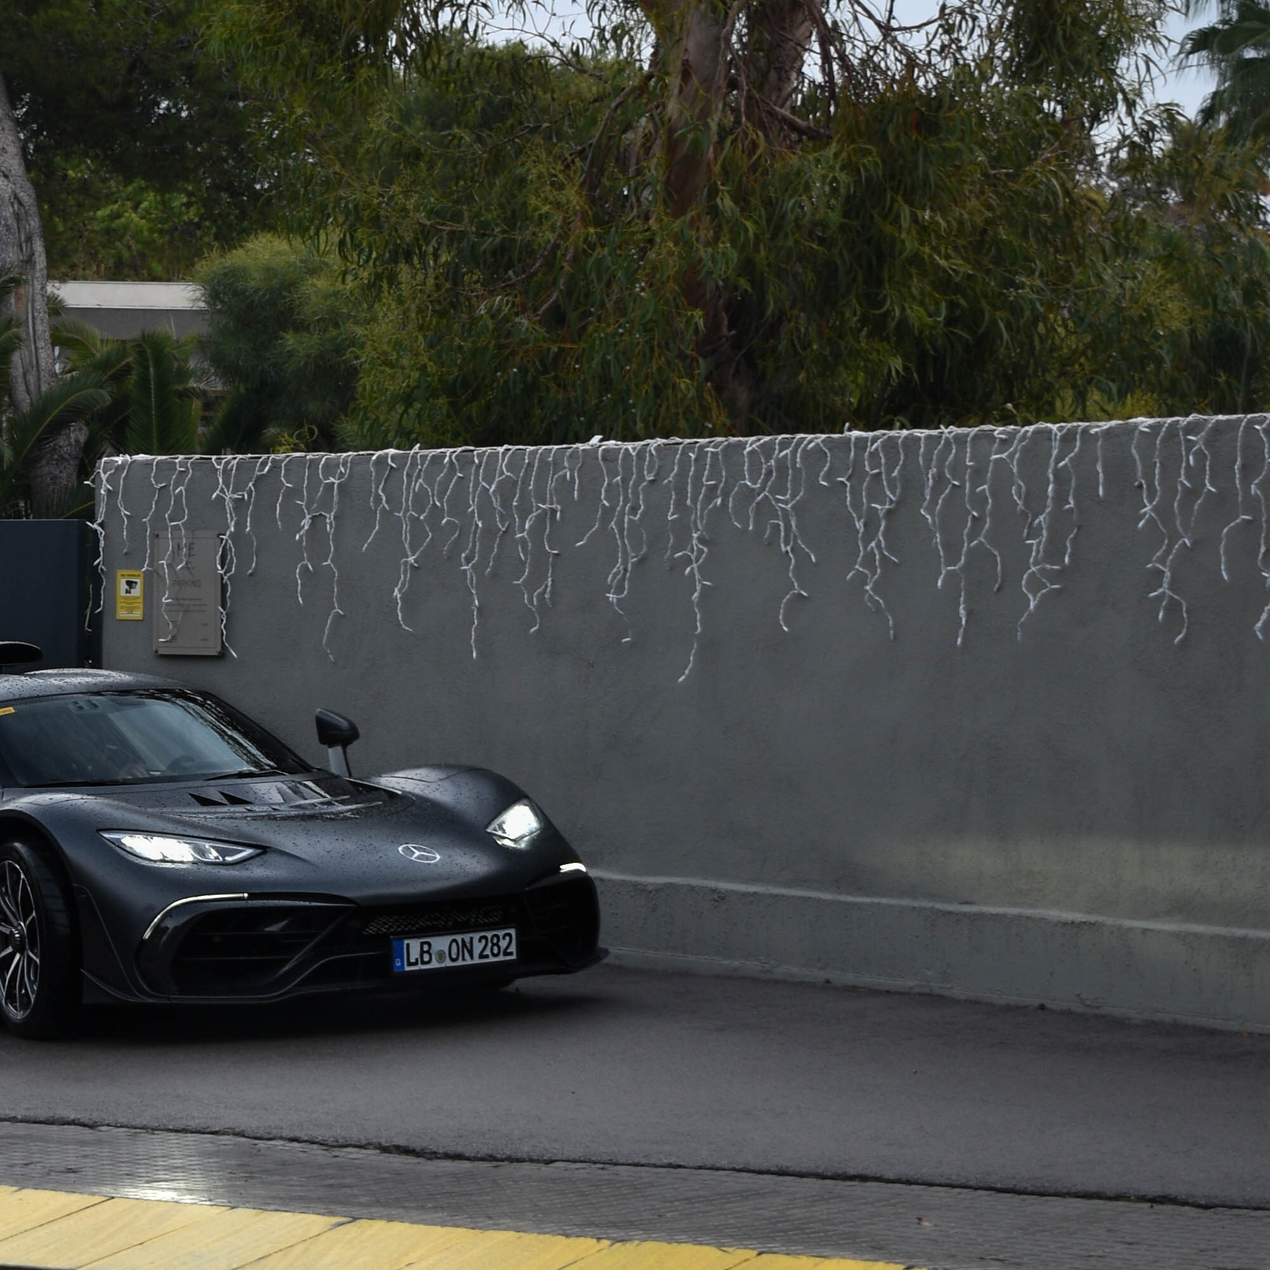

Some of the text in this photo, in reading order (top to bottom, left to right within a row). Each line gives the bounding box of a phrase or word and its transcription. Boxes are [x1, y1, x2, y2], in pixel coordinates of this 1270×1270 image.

[405, 932, 514, 967] LB ON 282
